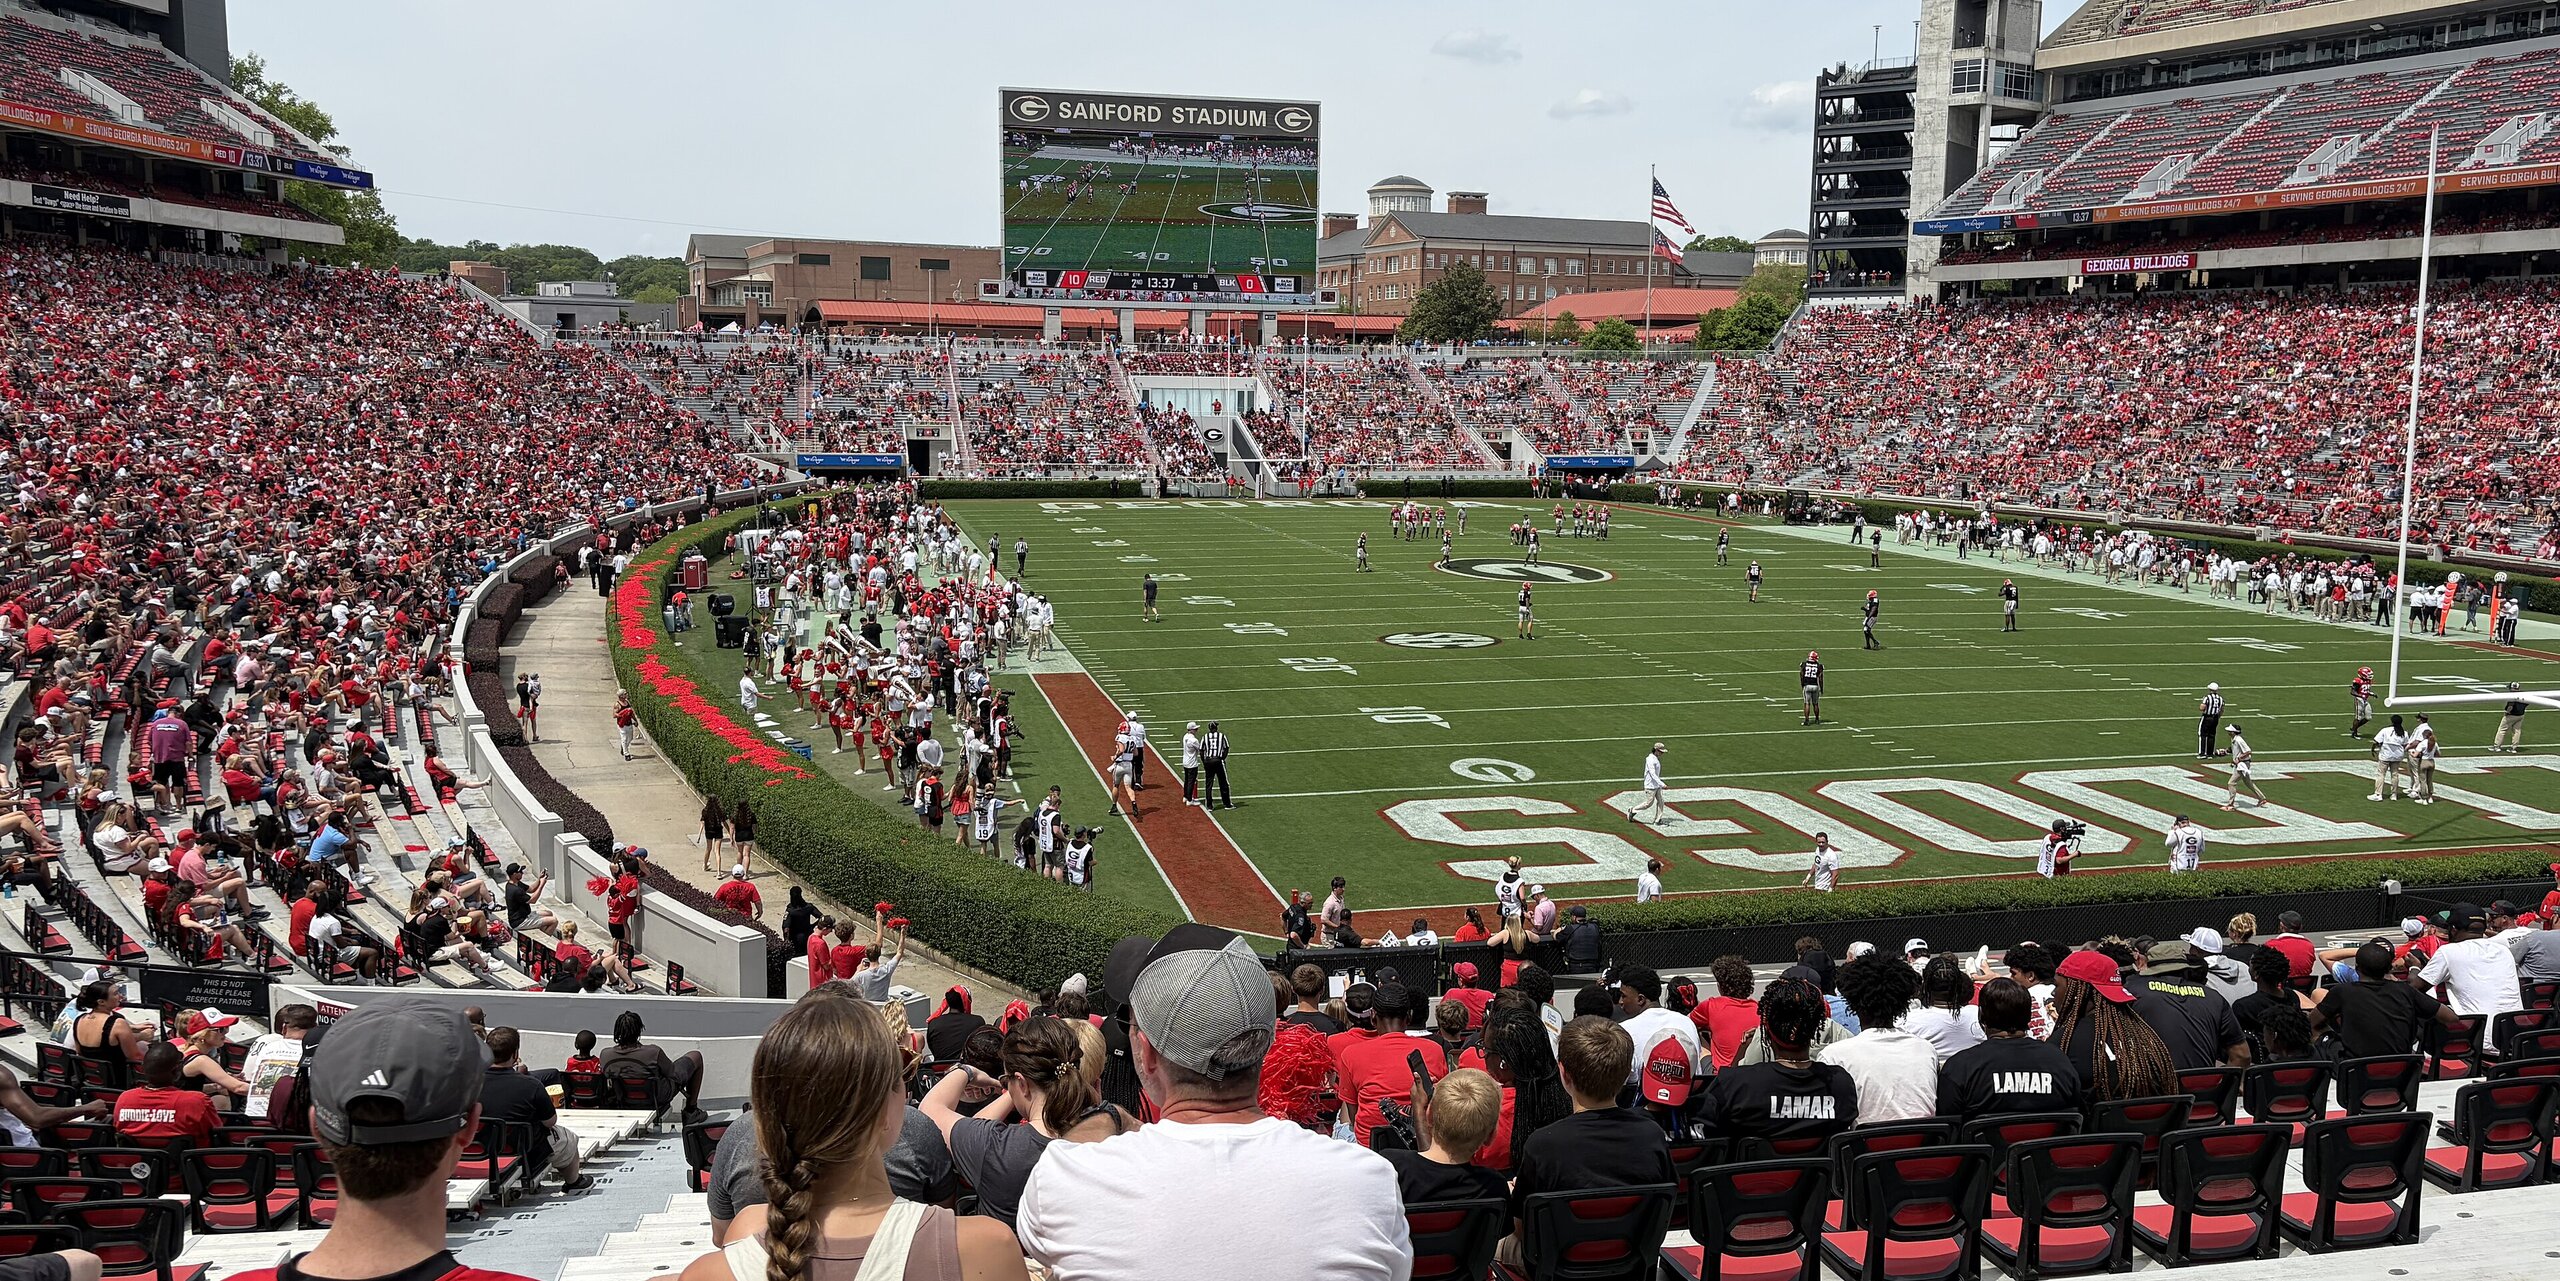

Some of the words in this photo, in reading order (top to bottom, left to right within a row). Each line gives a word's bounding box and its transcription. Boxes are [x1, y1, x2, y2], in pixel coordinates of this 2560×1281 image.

[35, 112, 51, 126] 24/7
[1058, 101, 1162, 123] SANFORD
[1171, 107, 1267, 127] STADIUM
[85, 123, 113, 139] SERVING
[113, 129, 142, 144] GEORGIA
[142, 134, 175, 149] BULLDOGS
[175, 141, 191, 154] 24/7
[214, 149, 226, 159] RED
[228, 151, 235, 163] 10
[246, 153, 264, 168] 13:37
[276, 158, 282, 171] 0
[2461, 174, 2498, 187] SERVING
[2500, 170, 2539, 183] GEORGIA
[64, 191, 80, 201] Need
[81, 193, 99, 204] Help?
[2281, 190, 2314, 203] SERVING
[2316, 187, 2351, 199] GEORGIA
[2352, 183, 2395, 197] BULLDOGS
[2396, 182, 2416, 193] 24/7
[2119, 207, 2150, 217] SERVING
[2150, 204, 2183, 214] GEORGIA
[2183, 200, 2222, 211] BULLDOGS
[2223, 198, 2242, 208] 24/7
[2072, 212, 2089, 222] 13:37
[2086, 259, 2131, 272] GEORGIA
[2132, 254, 2190, 270] BULLDOGS
[1069, 275, 1079, 285] 10
[1147, 278, 1176, 288] 13:37
[1246, 280, 1253, 289] 0
[1037, 501, 1518, 510] GEORGIA
[1750, 566, 1759, 576] 46
[1279, 657, 1354, 672] 20
[1804, 667, 1818, 678] 22
[1358, 706, 1444, 724] 10
[1126, 740, 1136, 753] 12
[978, 828, 989, 839] 19
[2186, 858, 2196, 868] 17
[203, 979, 219, 987] THIS
[203, 988, 223, 996] AISLE
[225, 989, 252, 998] PLEASE
[186, 995, 217, 1004] RESPECT
[219, 997, 252, 1006] PATRONS
[321, 1005, 348, 1016] ATTENT
[1993, 1072, 2052, 1094] LAMAR
[1769, 1095, 1836, 1120] LAMAR
[118, 1107, 176, 1124] BUDDIE-LOVE
